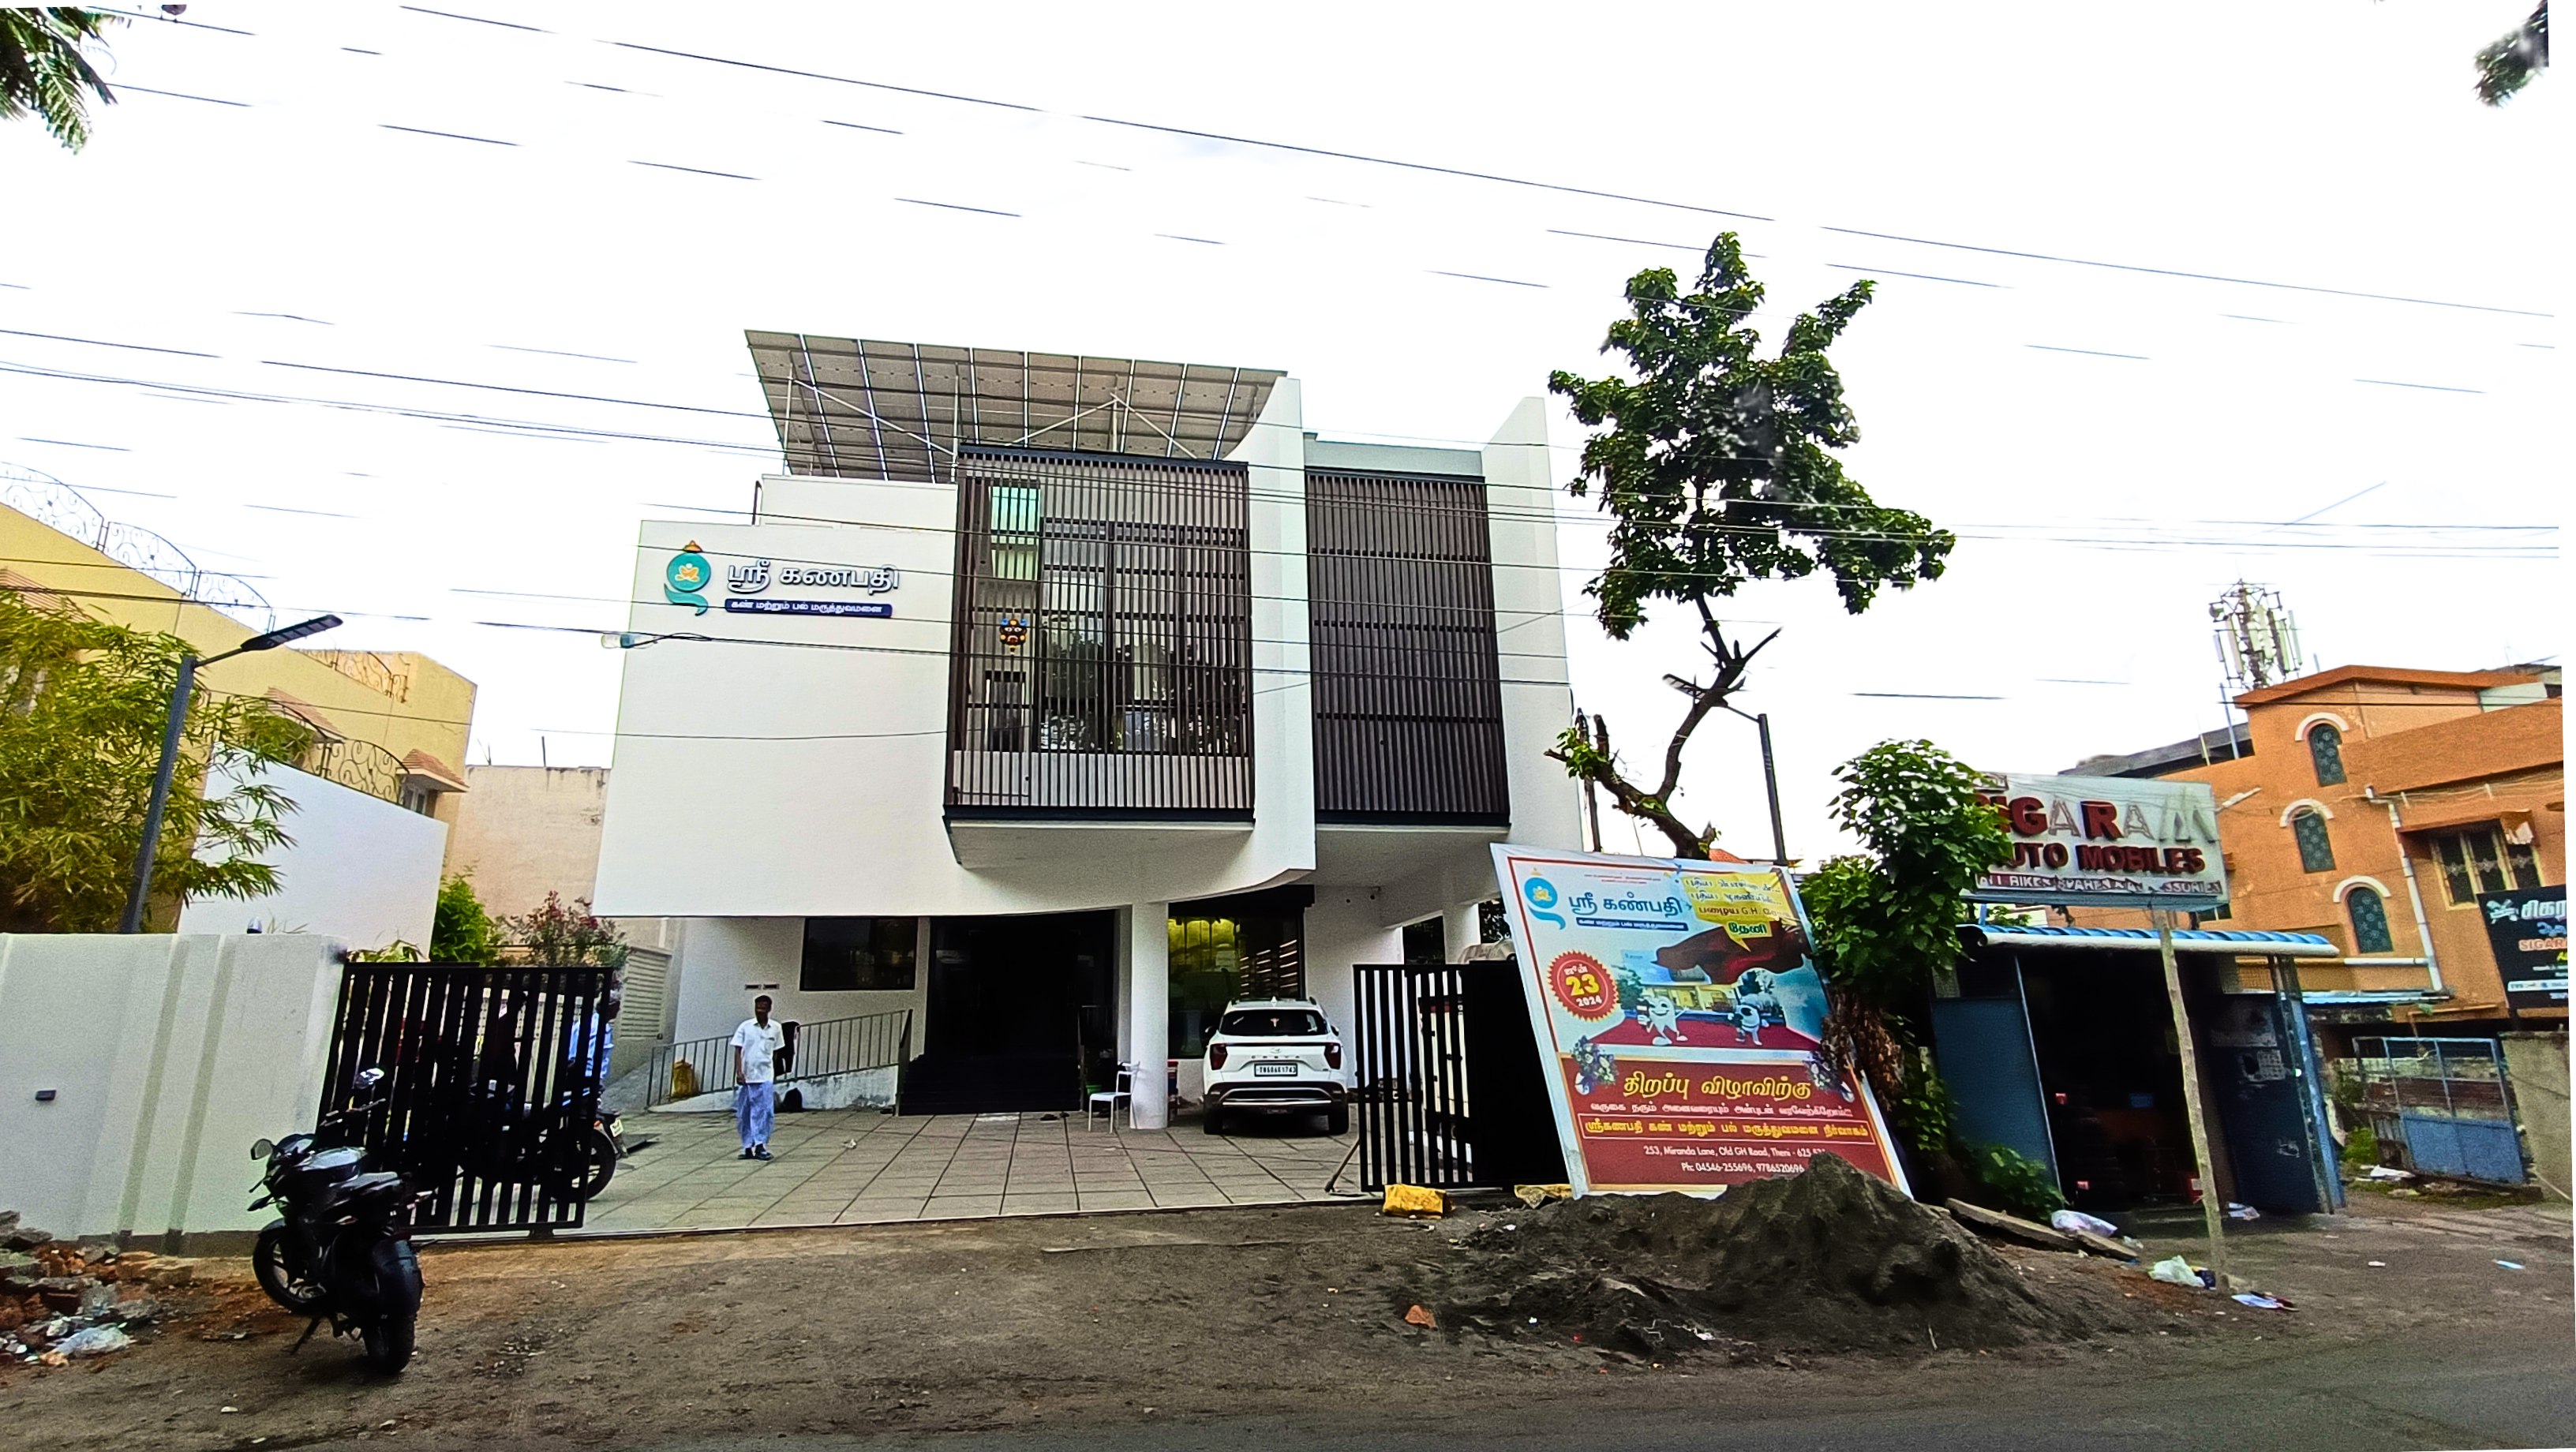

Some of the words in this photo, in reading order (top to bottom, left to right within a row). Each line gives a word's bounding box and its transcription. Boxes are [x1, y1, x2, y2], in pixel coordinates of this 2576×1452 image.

[728, 557, 771, 594] ஸ்ரீ
[779, 563, 900, 596] கணபதி
[2075, 844, 2206, 874] MOBILES
[1569, 892, 1597, 915] ஸ்ரீ
[1728, 922, 1767, 934] தேனி
[1566, 974, 1600, 996] 23
[1576, 995, 1602, 1007] 2024
[1623, 1071, 1690, 1100] திறப்பு
[1701, 1076, 1811, 1101] விழாவிற்கு
[1719, 1146, 1733, 1156] Old
[1748, 1147, 1770, 1158] Road,
